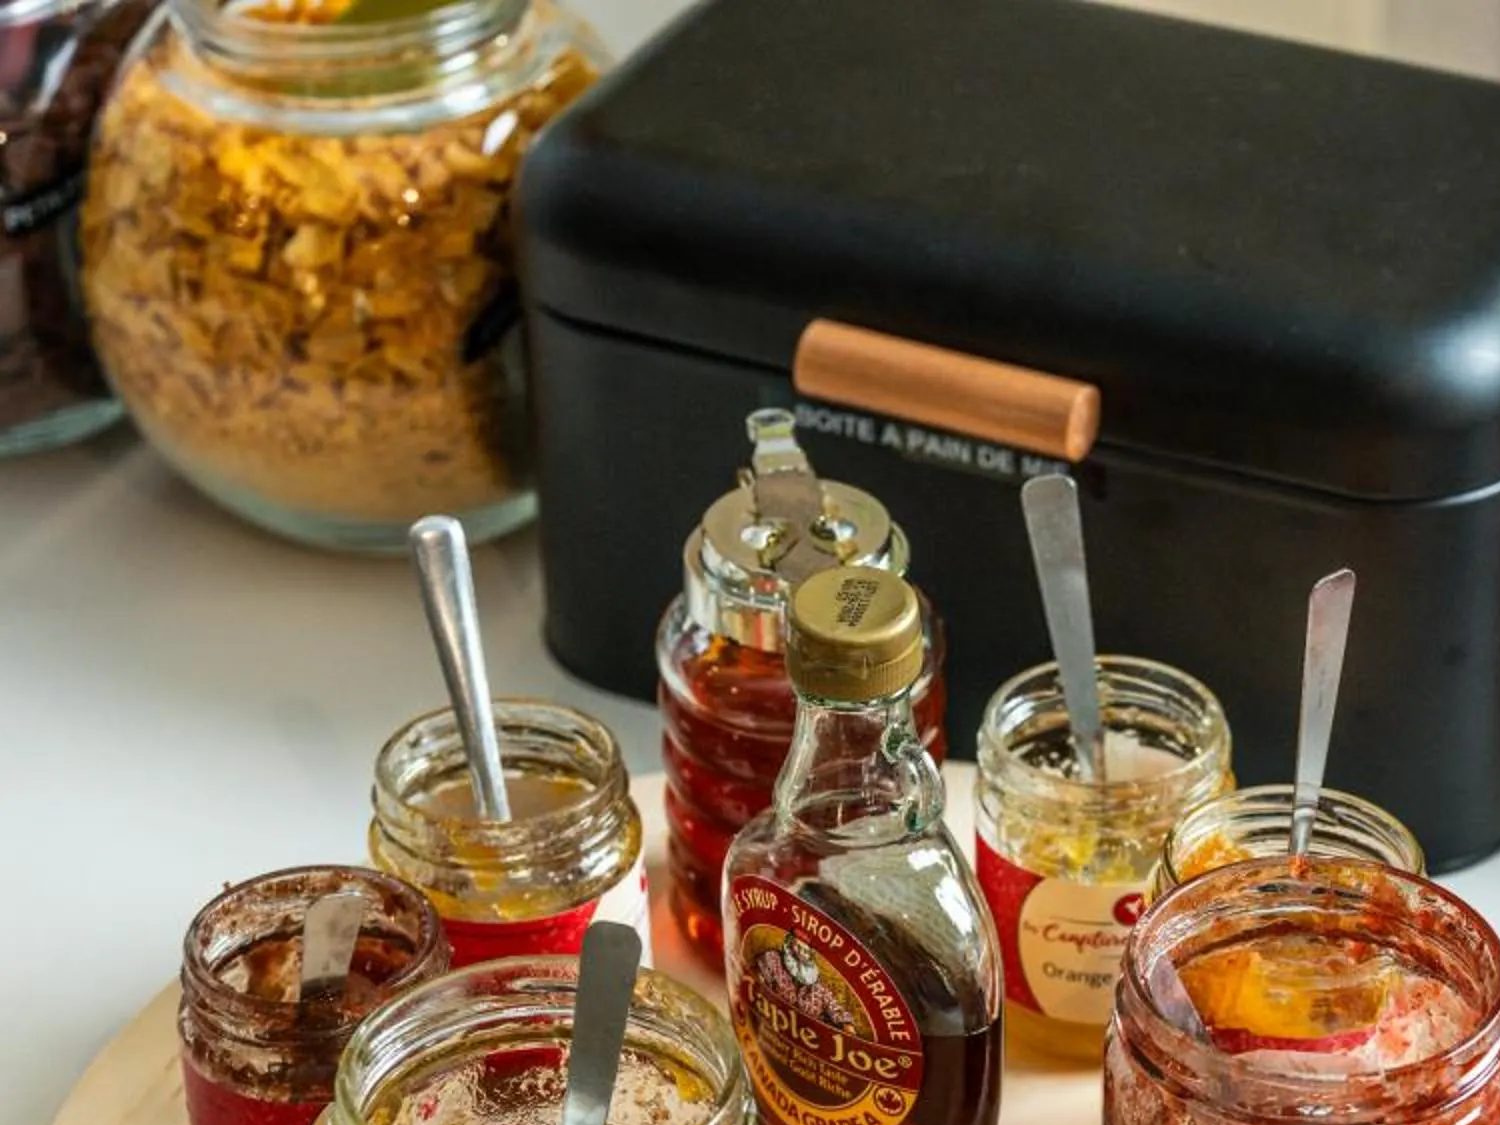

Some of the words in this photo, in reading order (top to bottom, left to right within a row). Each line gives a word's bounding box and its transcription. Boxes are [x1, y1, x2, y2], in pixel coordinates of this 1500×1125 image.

[880, 422, 901, 448] A
[906, 428, 971, 464] PAIN
[976, 445, 1015, 473] DE
[790, 904, 845, 950] SIROP
[843, 948, 912, 1042] D'ÉRABLE
[750, 984, 820, 1050] aple
